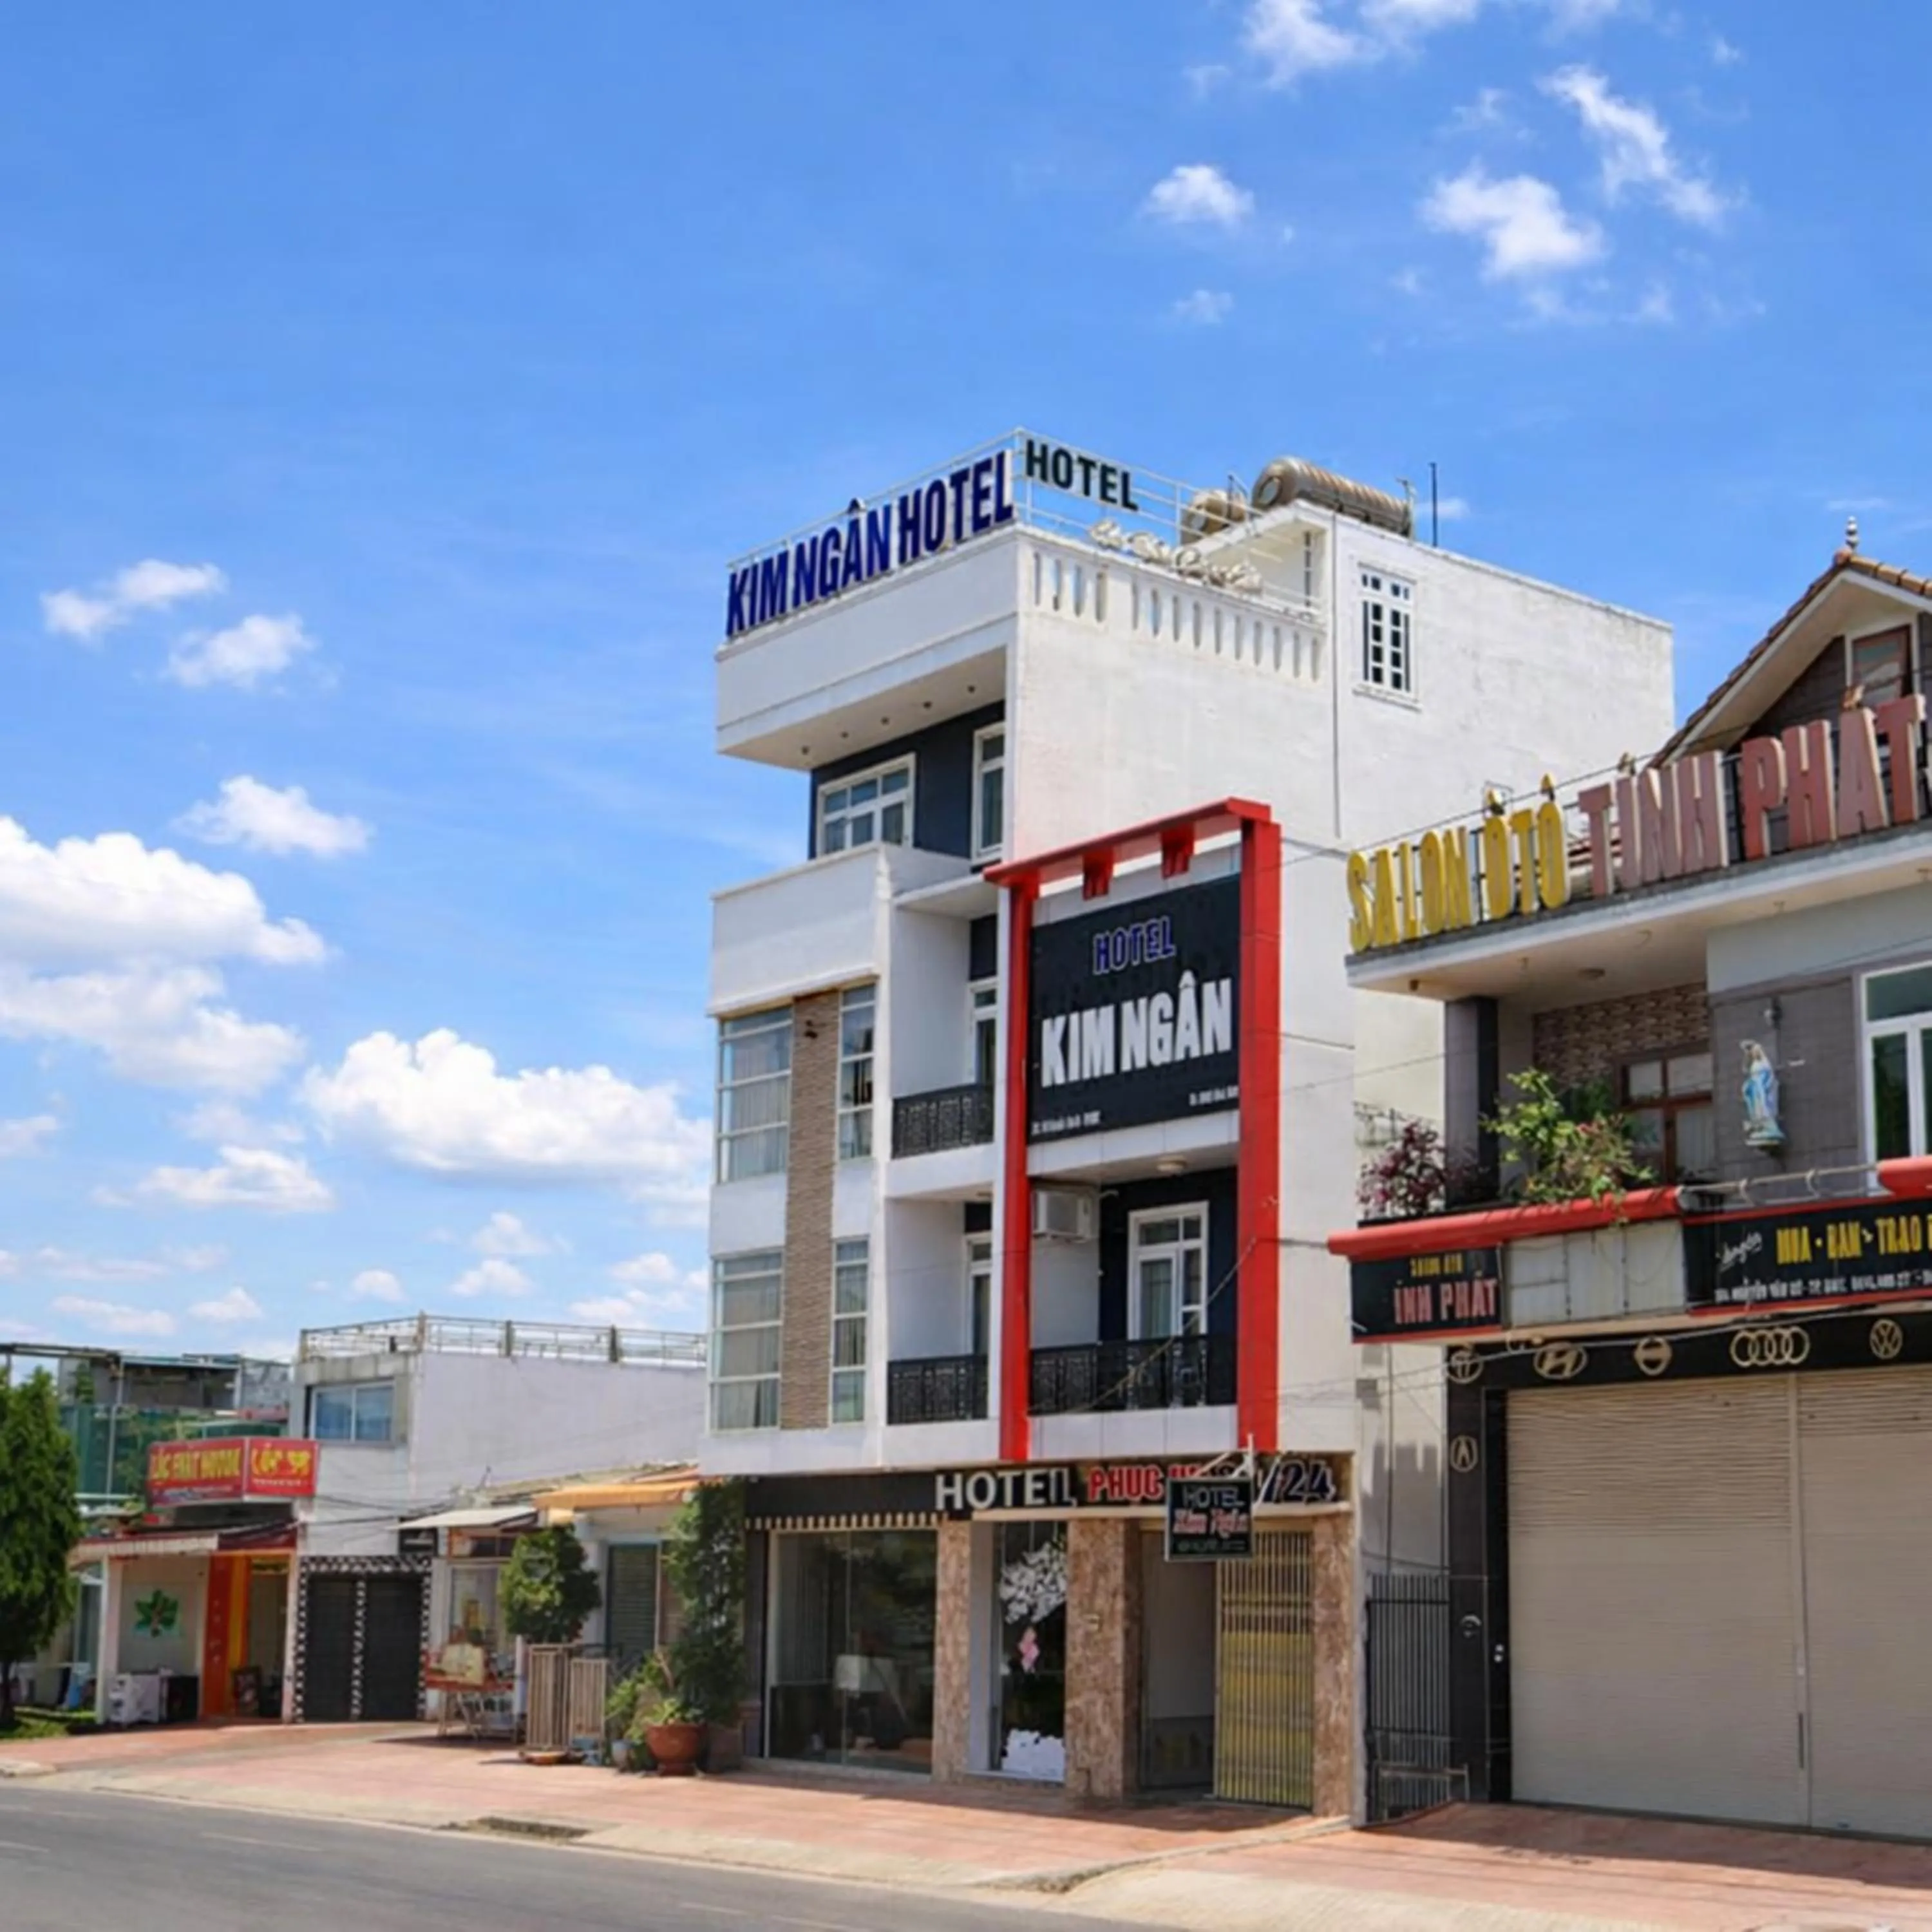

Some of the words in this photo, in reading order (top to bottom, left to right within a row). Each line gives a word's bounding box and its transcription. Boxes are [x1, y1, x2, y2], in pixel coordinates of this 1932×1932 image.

[1025, 439, 1139, 512] HOTEL
[726, 550, 787, 638] KIM
[791, 497, 892, 609] NGÂN
[898, 449, 1014, 564] HOTEL
[1347, 825, 1479, 955] SALON
[1093, 915, 1176, 976] HOTEL
[1041, 1004, 1116, 1088] KIM
[1120, 969, 1233, 1073] NGÂN
[935, 1466, 1078, 1511] HOTEL
[1183, 1484, 1246, 1510] HOTEL
